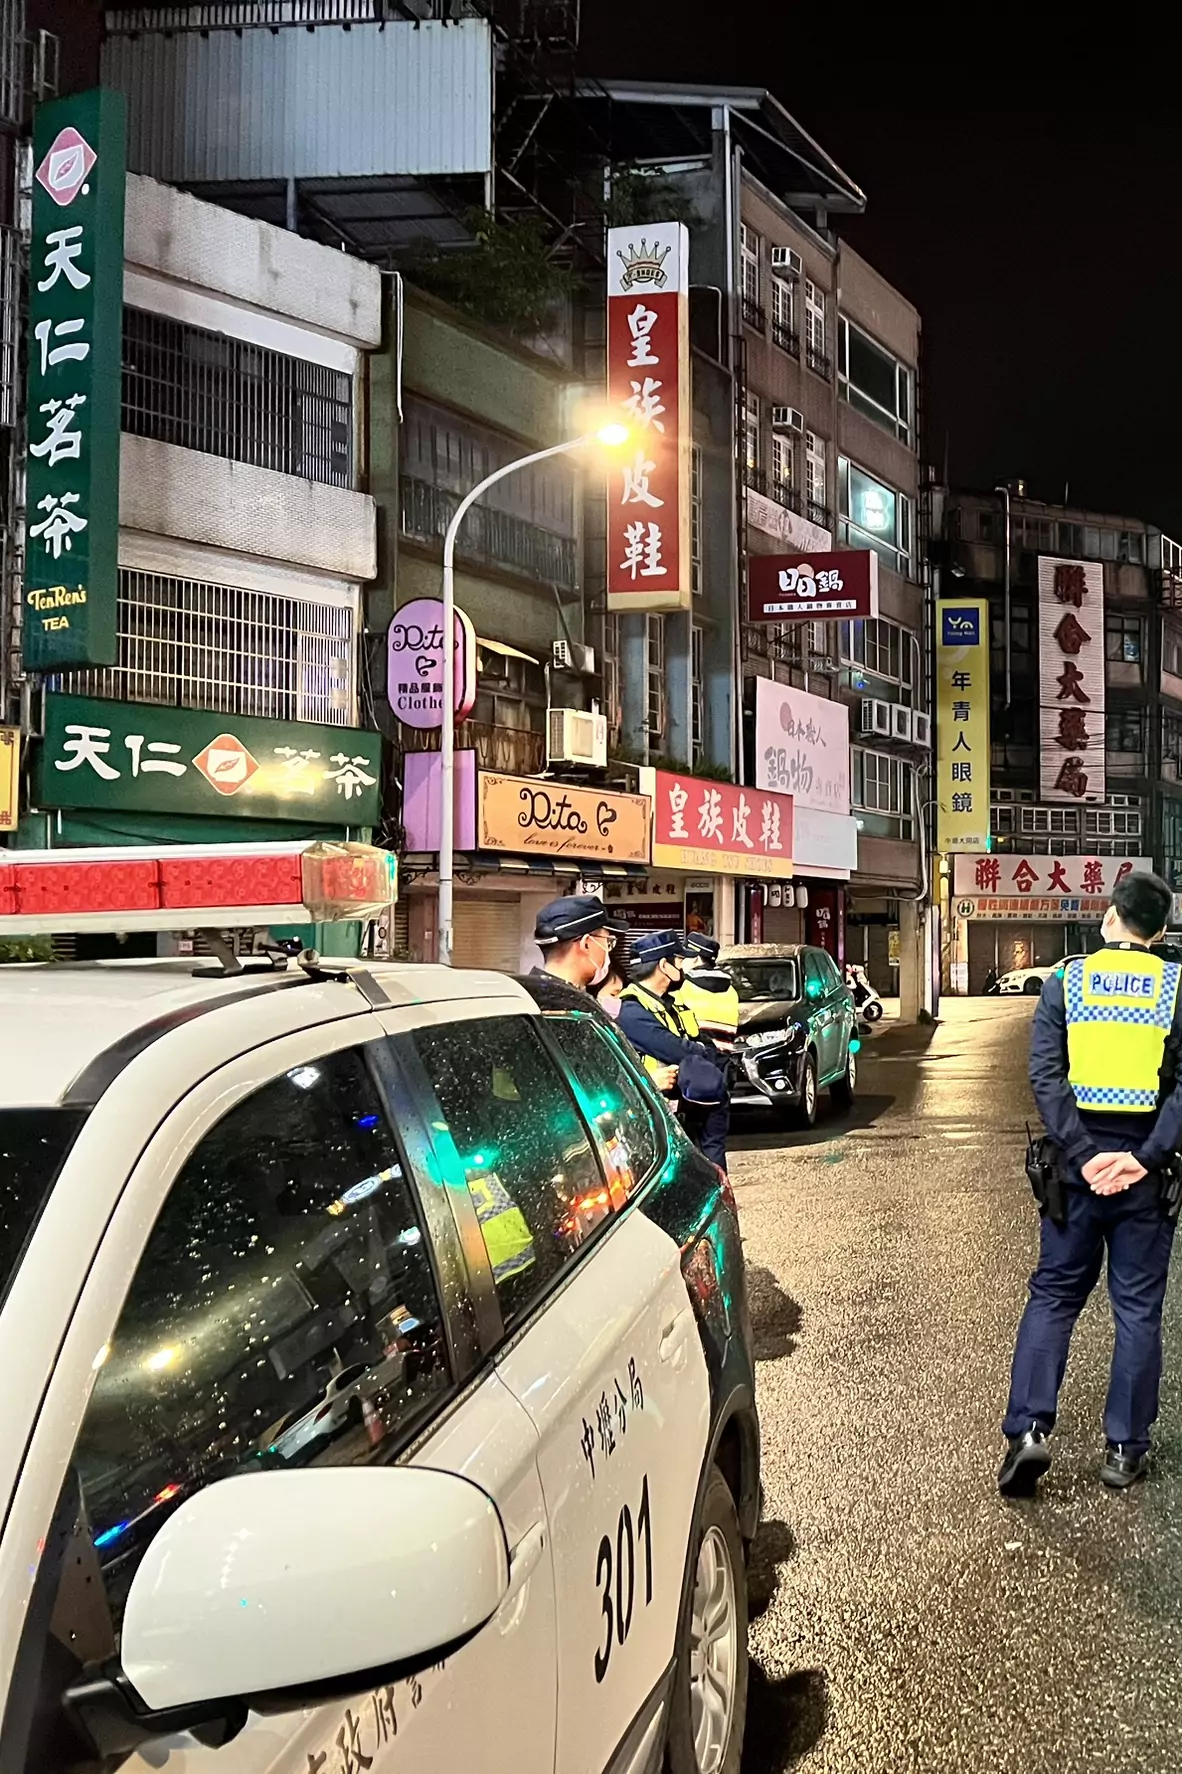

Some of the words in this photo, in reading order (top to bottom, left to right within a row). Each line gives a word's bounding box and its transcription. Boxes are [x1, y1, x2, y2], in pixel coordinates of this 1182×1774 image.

[29, 225, 91, 559] 天仁茗茶
[619, 303, 667, 580] 皇族皮鞋
[42, 615, 69, 632] TEA
[764, 746, 813, 793] 鍋物
[951, 670, 972, 813] 年青人眼鏡
[518, 788, 587, 833] Rita
[668, 782, 783, 851] 皇族皮鞋
[1092, 975, 1152, 994] POLICE
[581, 1357, 645, 1480] 中壢分局
[594, 1473, 654, 1684] 301
